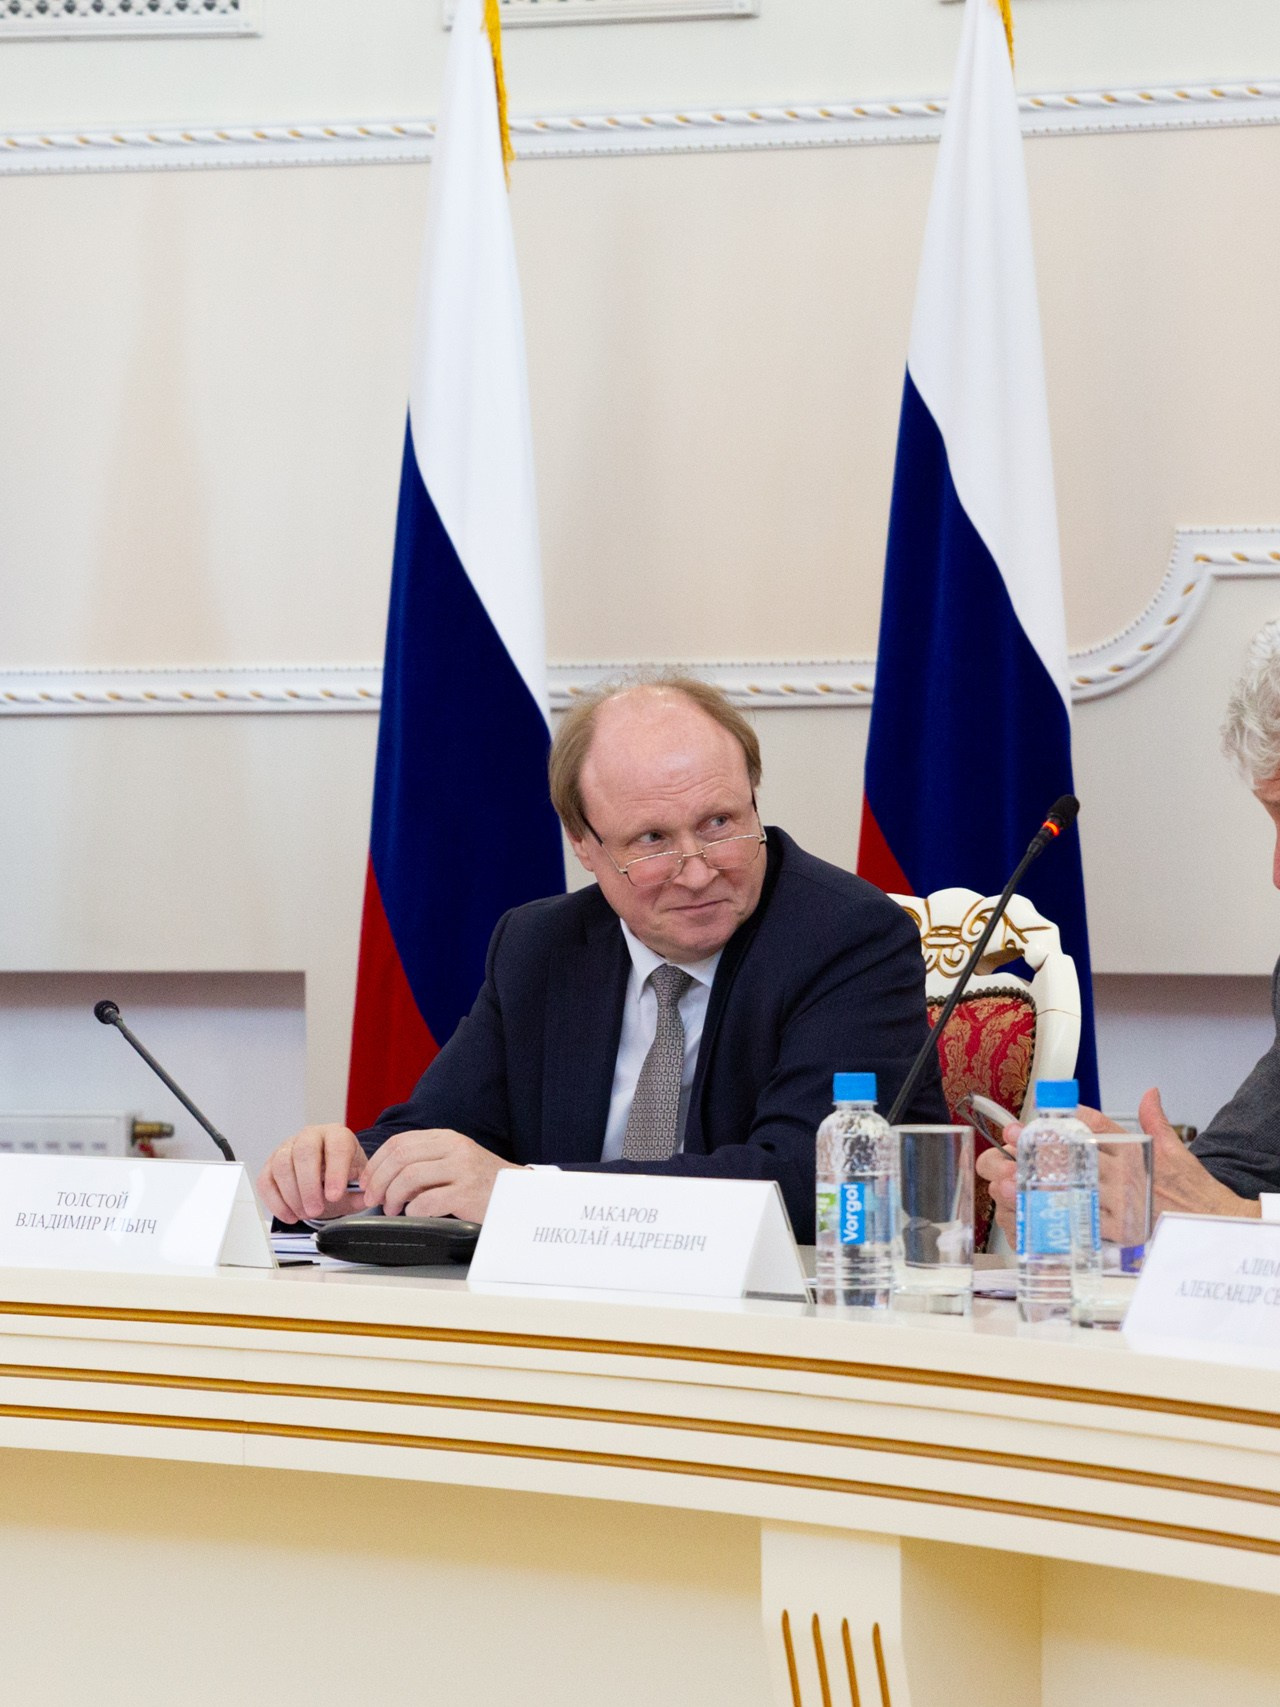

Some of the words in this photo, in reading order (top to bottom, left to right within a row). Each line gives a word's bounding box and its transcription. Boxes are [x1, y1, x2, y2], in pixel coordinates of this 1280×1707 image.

[57, 1191, 129, 1210] ТОЛСТОЙ
[15, 1212, 101, 1231] ВЛАДИМИР
[580, 1205, 658, 1223] МАКАРОВ
[842, 1184, 862, 1242] Vorgol
[532, 1226, 608, 1246] НИКОЛАЙ
[611, 1232, 707, 1251] АНДРЕЕВИЧ
[1175, 1280, 1263, 1305] АЛЕКСАНДР
